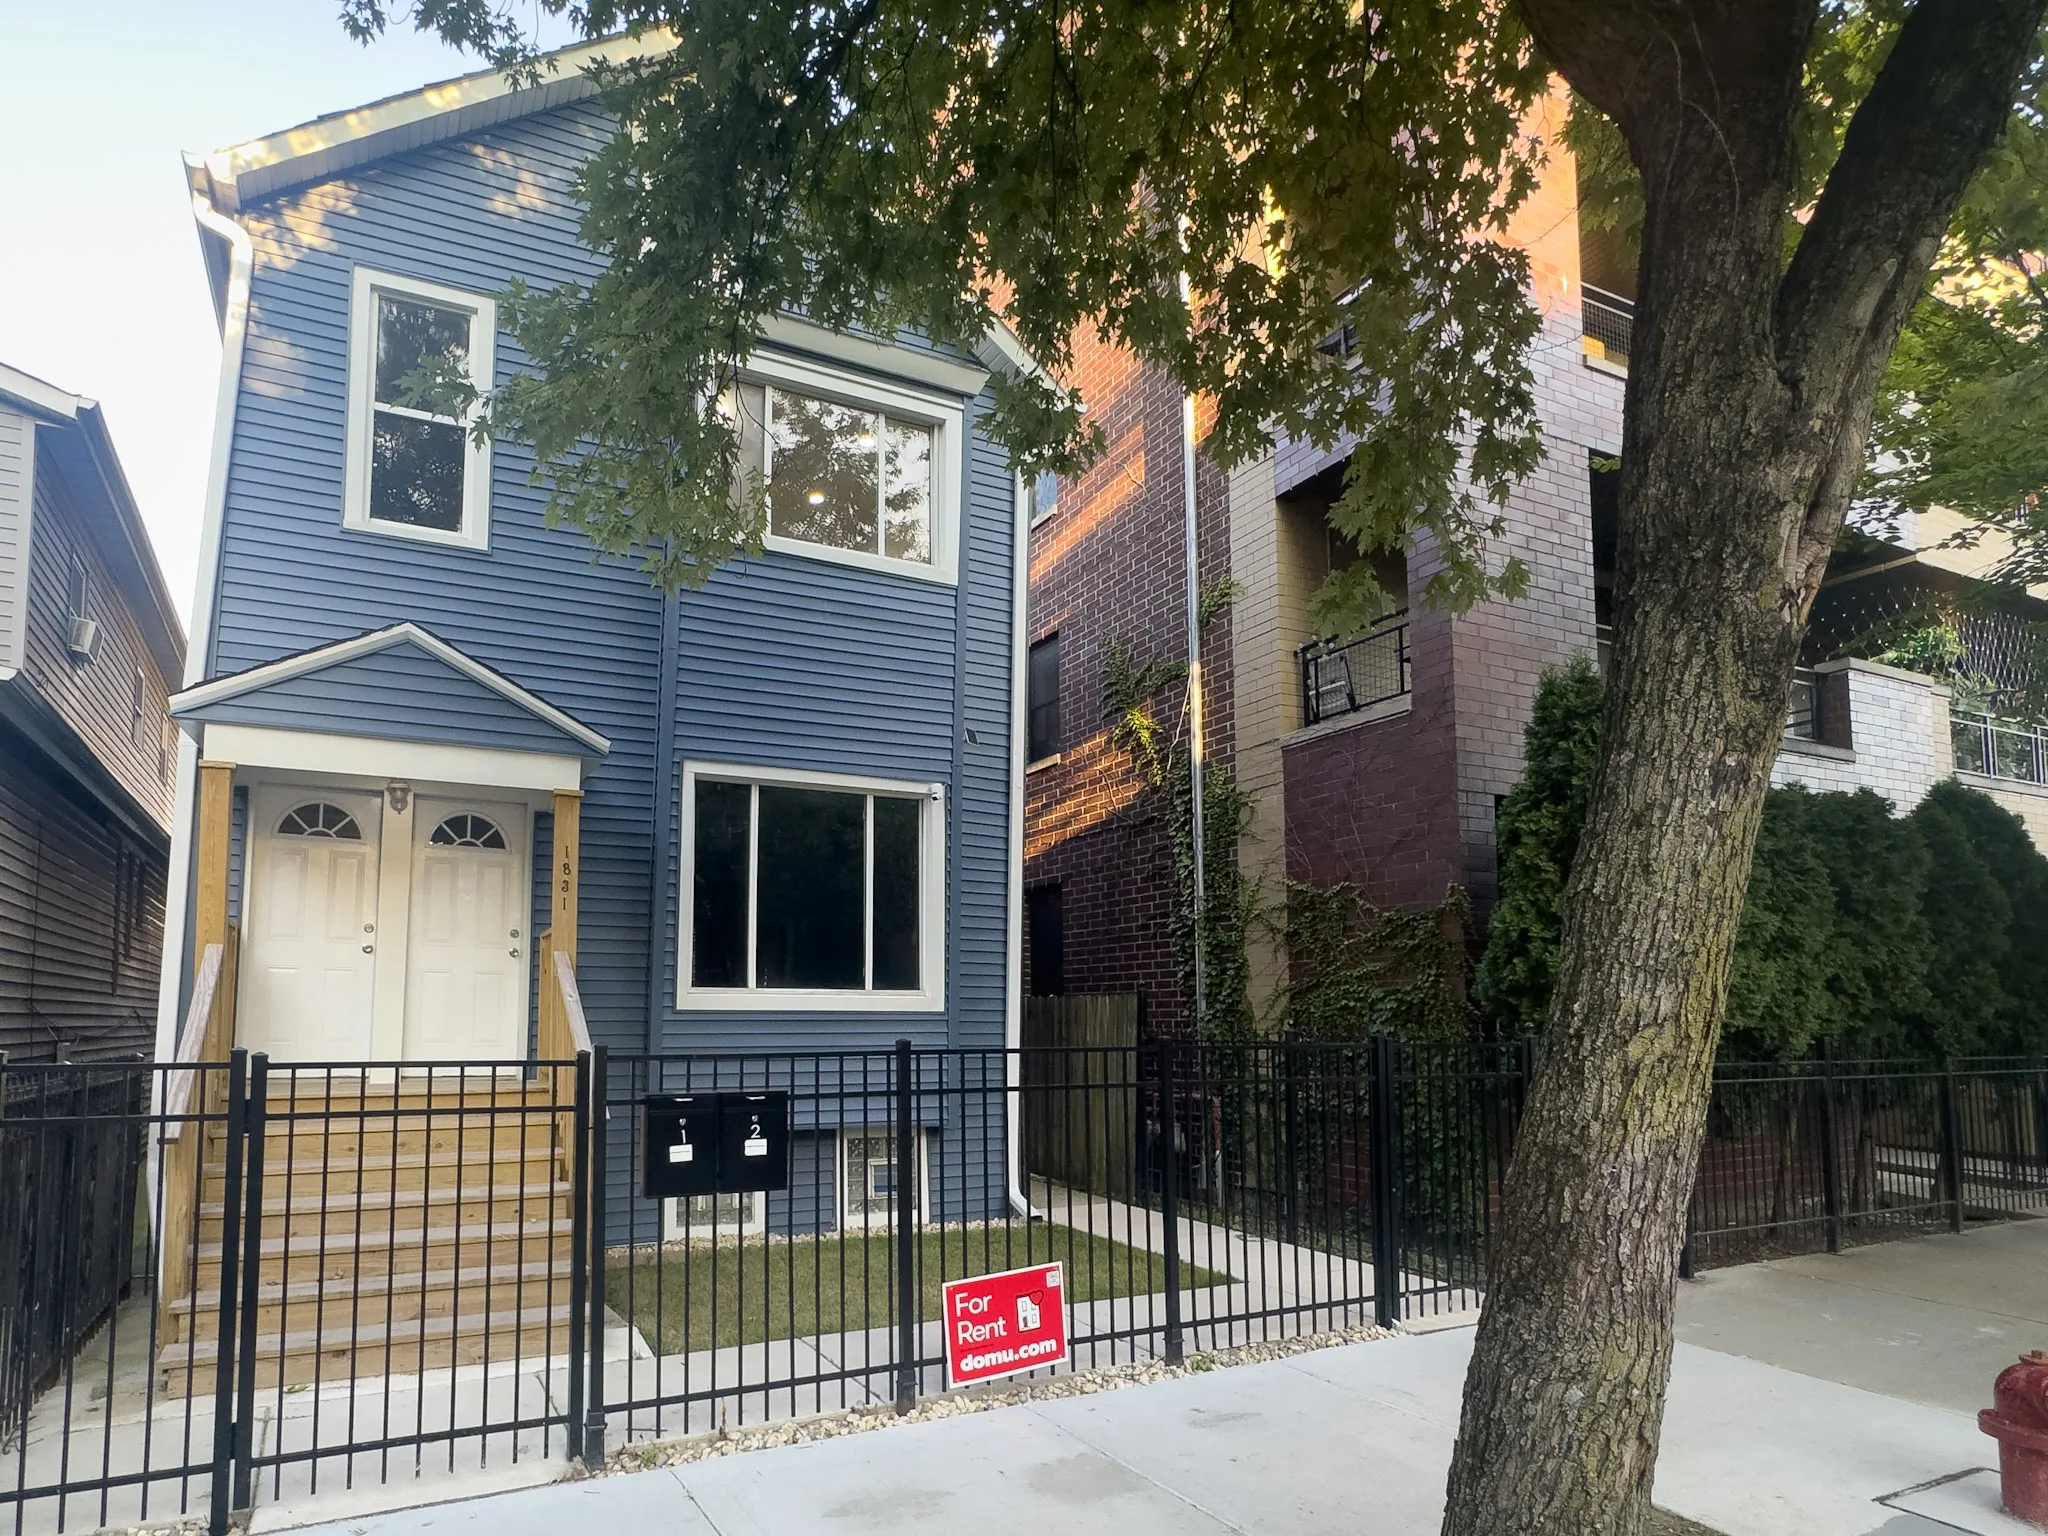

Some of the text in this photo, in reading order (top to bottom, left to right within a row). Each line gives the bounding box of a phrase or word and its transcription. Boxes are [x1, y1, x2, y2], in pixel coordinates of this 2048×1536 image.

[561, 845, 571, 911] 1831
[681, 1129, 686, 1144] 1
[750, 1124, 761, 1138] 2
[955, 1292, 993, 1317] For
[957, 1316, 1007, 1345] Rent
[960, 1338, 1057, 1372] domu.com
